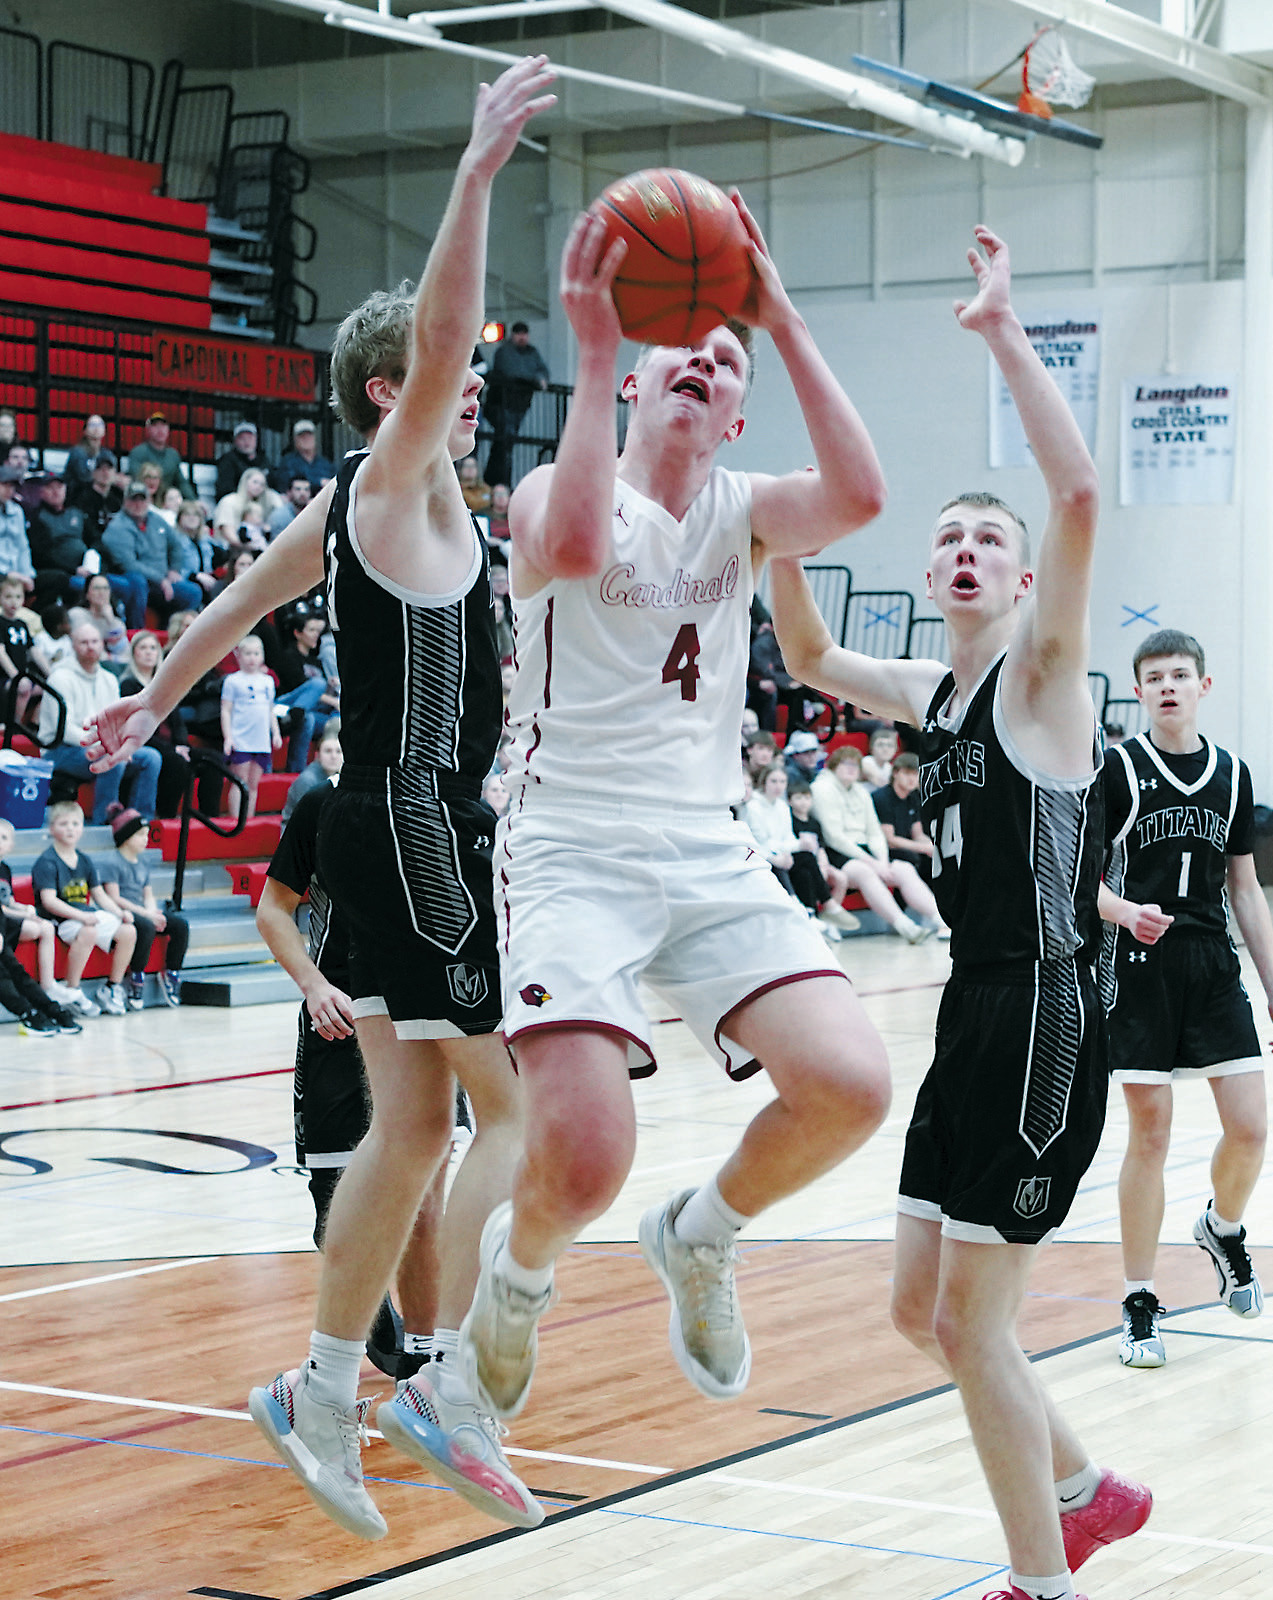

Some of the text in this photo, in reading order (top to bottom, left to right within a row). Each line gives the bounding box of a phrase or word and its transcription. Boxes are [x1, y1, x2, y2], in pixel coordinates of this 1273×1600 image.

[1023, 319, 1097, 340] angdon
[157, 339, 312, 396] CARDINAL FANS
[1041, 356, 1078, 368] ATE
[1135, 384, 1229, 405] Langdon
[1158, 405, 1202, 417] GIRLS
[1131, 414, 1228, 429] CROSS COUNTRY
[1153, 430, 1206, 444] STATE
[600, 554, 739, 608] Cardinal
[661, 622, 701, 702] 4
[919, 739, 985, 807] ITANS
[1136, 806, 1229, 853] TITANS
[1177, 851, 1193, 898] 1
